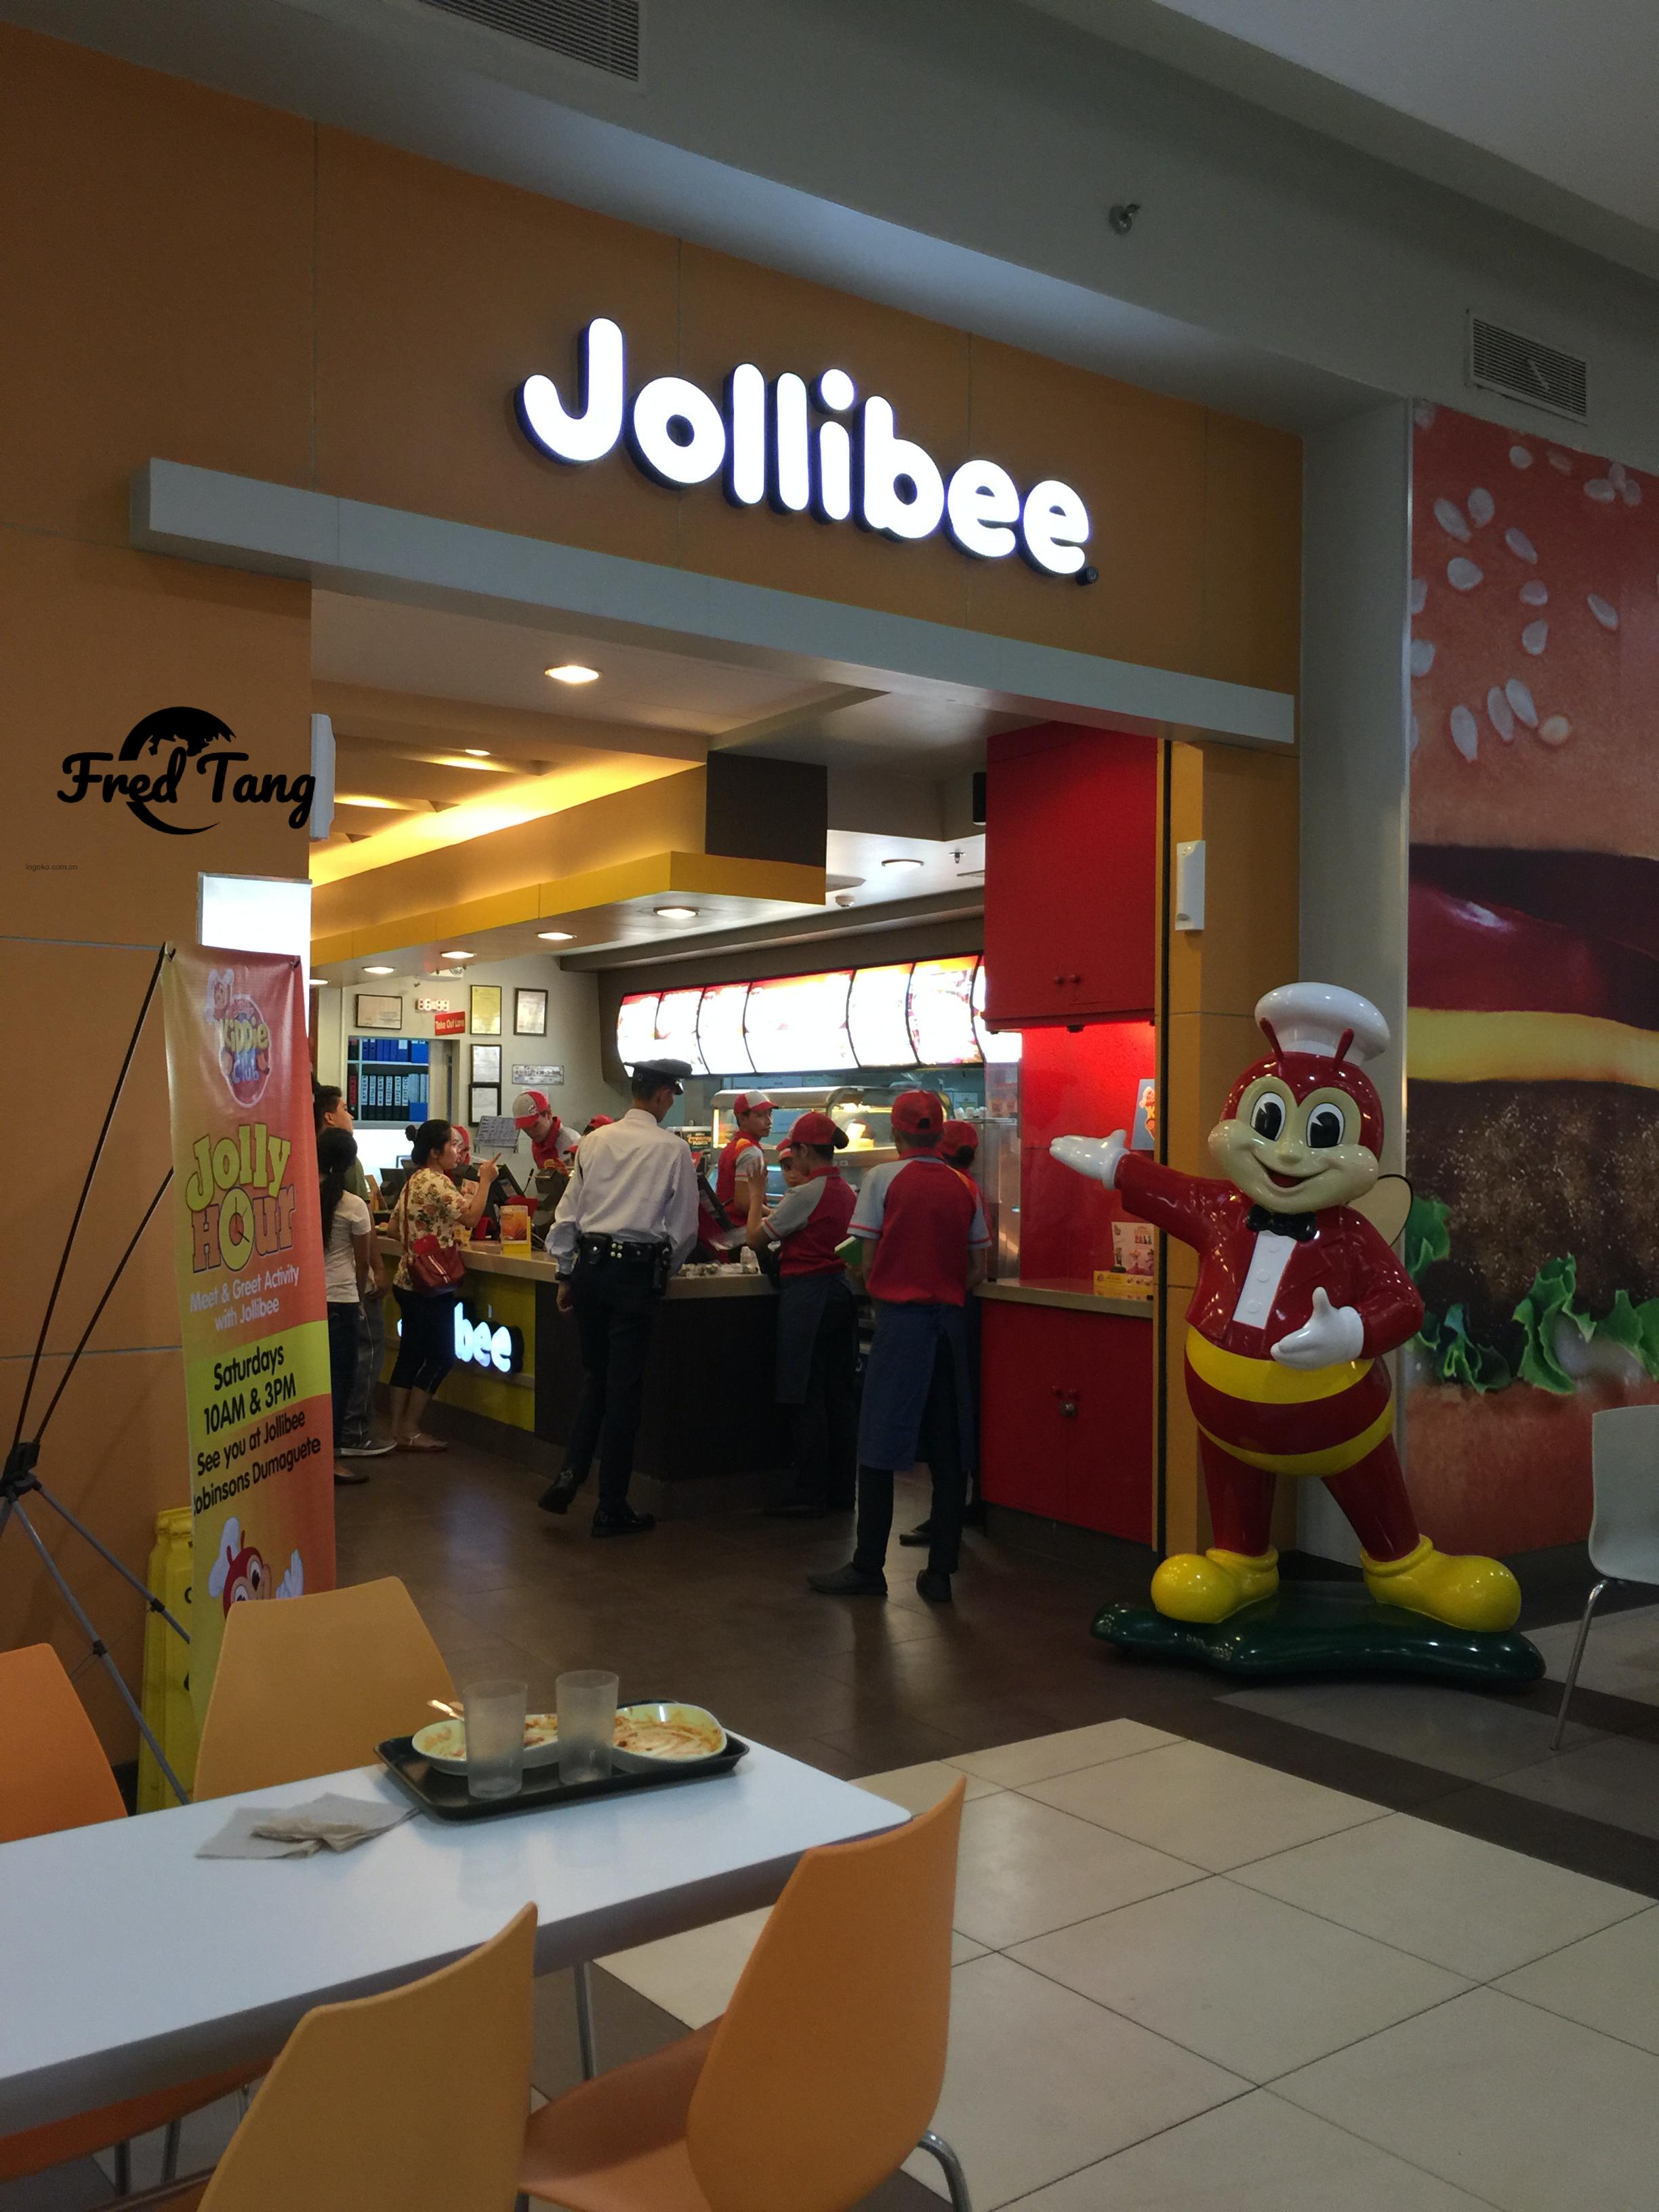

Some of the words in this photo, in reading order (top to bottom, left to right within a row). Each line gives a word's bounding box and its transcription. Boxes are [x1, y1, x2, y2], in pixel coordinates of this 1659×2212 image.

[518, 316, 1092, 577] Jollibee
[232, 1059, 259, 1084] Club
[186, 1122, 291, 1212] Jolly
[190, 1288, 219, 1313] Meet
[222, 1282, 230, 1303] &
[232, 1274, 262, 1299] Greet
[264, 1264, 300, 1290] Activity
[215, 1307, 237, 1332] with
[240, 1297, 279, 1324] Jollibee
[213, 1345, 284, 1391] Saturdays
[204, 1393, 246, 1435] 10AM
[249, 1388, 262, 1415] &
[264, 1372, 297, 1409] 3PM
[197, 1450, 221, 1476] See
[224, 1438, 246, 1469] you
[249, 1427, 262, 1451] at
[264, 1411, 306, 1444] Jollibee
[194, 1471, 251, 1516] obinsons
[252, 1437, 321, 1484] Dumaguete
